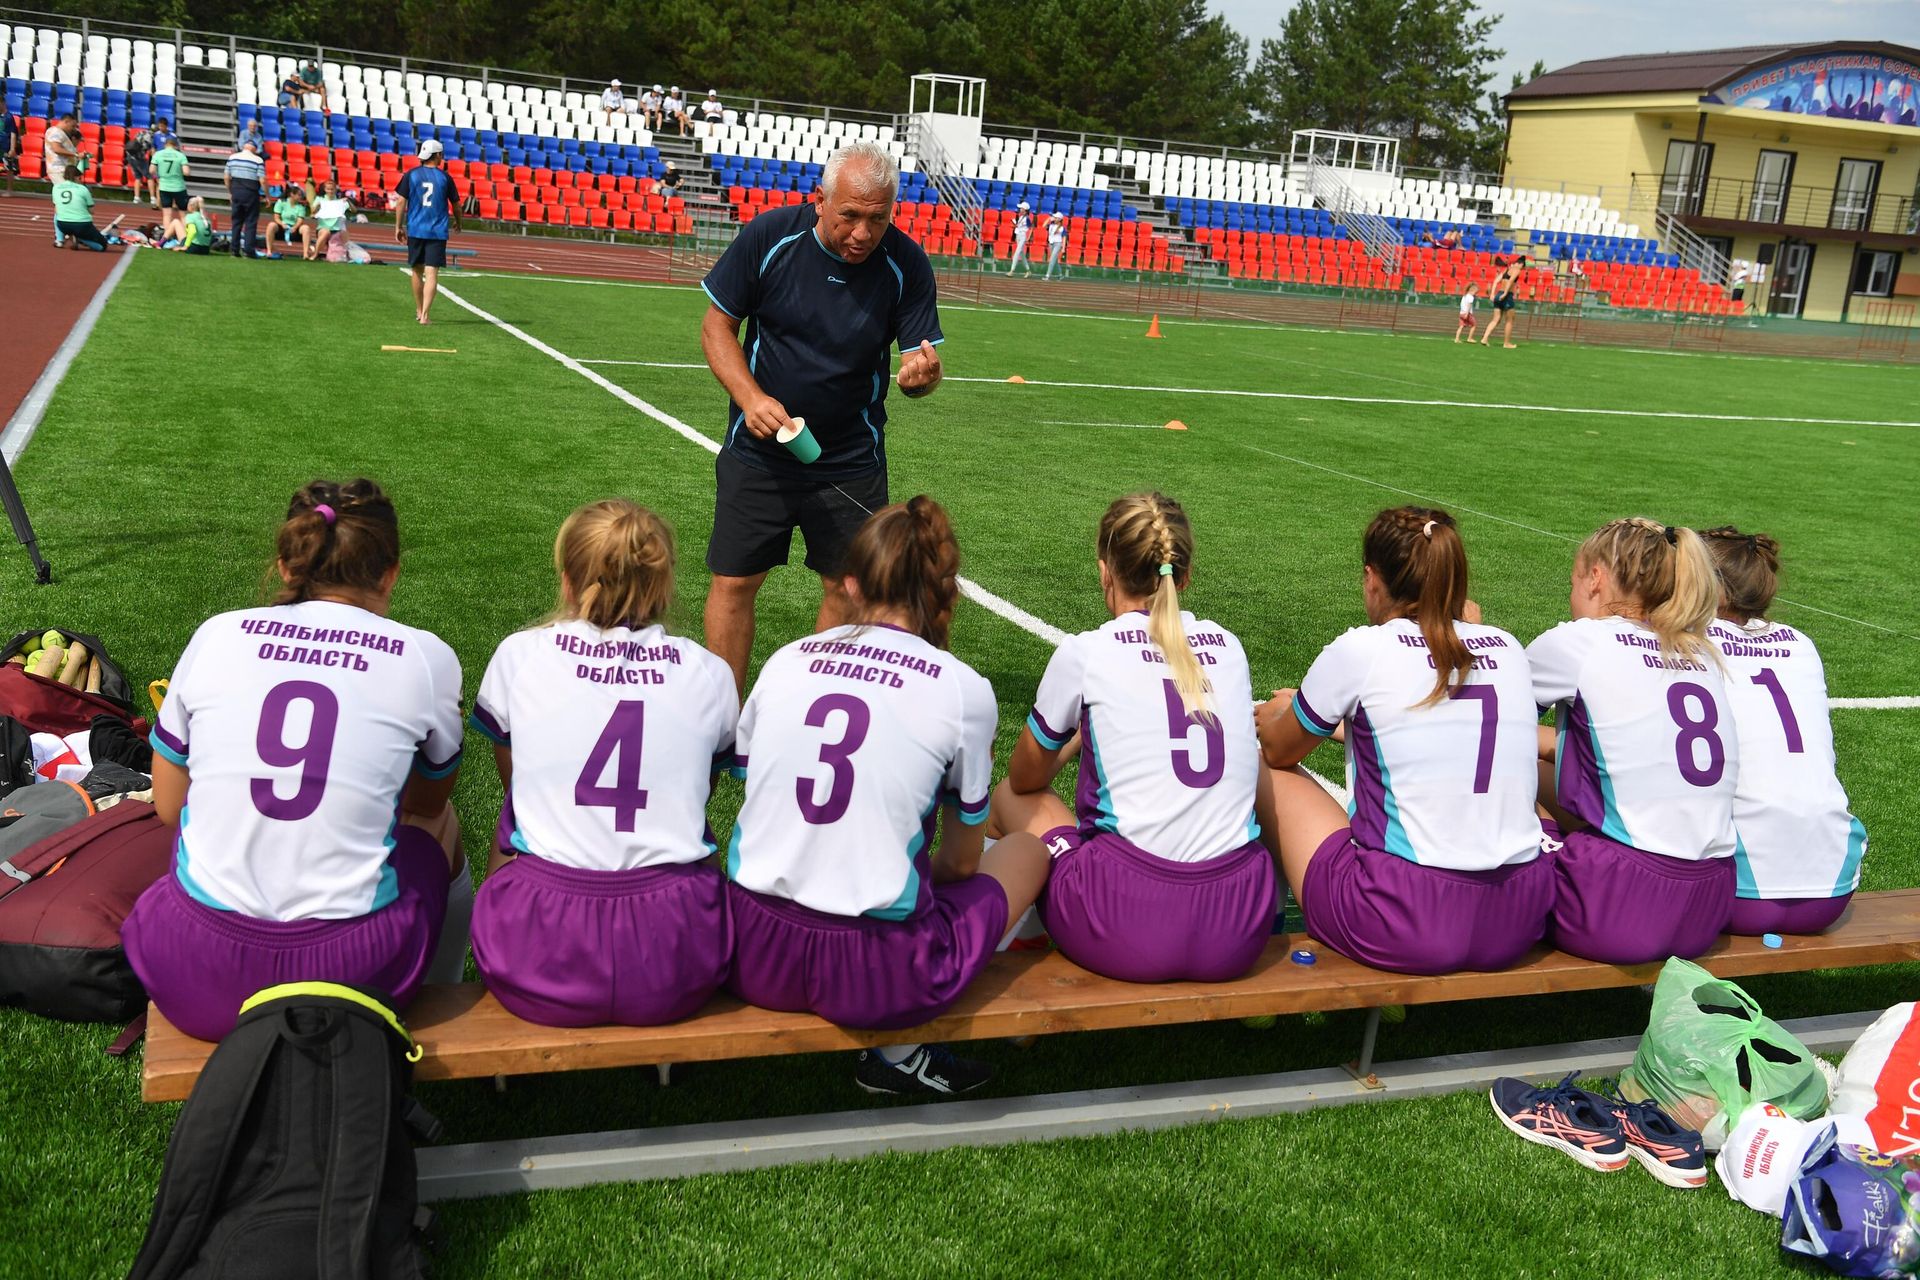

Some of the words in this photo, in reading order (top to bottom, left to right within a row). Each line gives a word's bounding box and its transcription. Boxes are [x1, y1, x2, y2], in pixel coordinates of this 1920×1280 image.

[1731, 68, 1786, 98] ПРИВЕТ
[1789, 55, 1882, 78] УЧАСТНИКАМ
[163, 160, 174, 174] 7
[60, 190, 73, 205] 9
[422, 182, 434, 207] 2
[240, 619, 405, 656] ЧЕЛЯБИНСКАЯ
[556, 634, 681, 665] ЧЕЛЯБИНСКАЯ
[258, 643, 369, 672] ОБЛАСТЬ
[576, 664, 665, 685] ОБЛАСТЬ
[799, 641, 942, 679] ЧЕЛЯБИНСКАЯ
[809, 658, 905, 689] ОБЛАСТЬ
[1750, 667, 1804, 753] 1
[250, 680, 339, 821] 9
[1162, 678, 1226, 789] 5
[1447, 684, 1498, 794] 7
[1666, 681, 1725, 787] 8
[575, 700, 648, 833] 4
[795, 693, 871, 825] 3
[1742, 1127, 1770, 1179] ЧЕЛЯБИНСКАЯ
[1759, 1140, 1780, 1175] ОБЛАСТЬ
